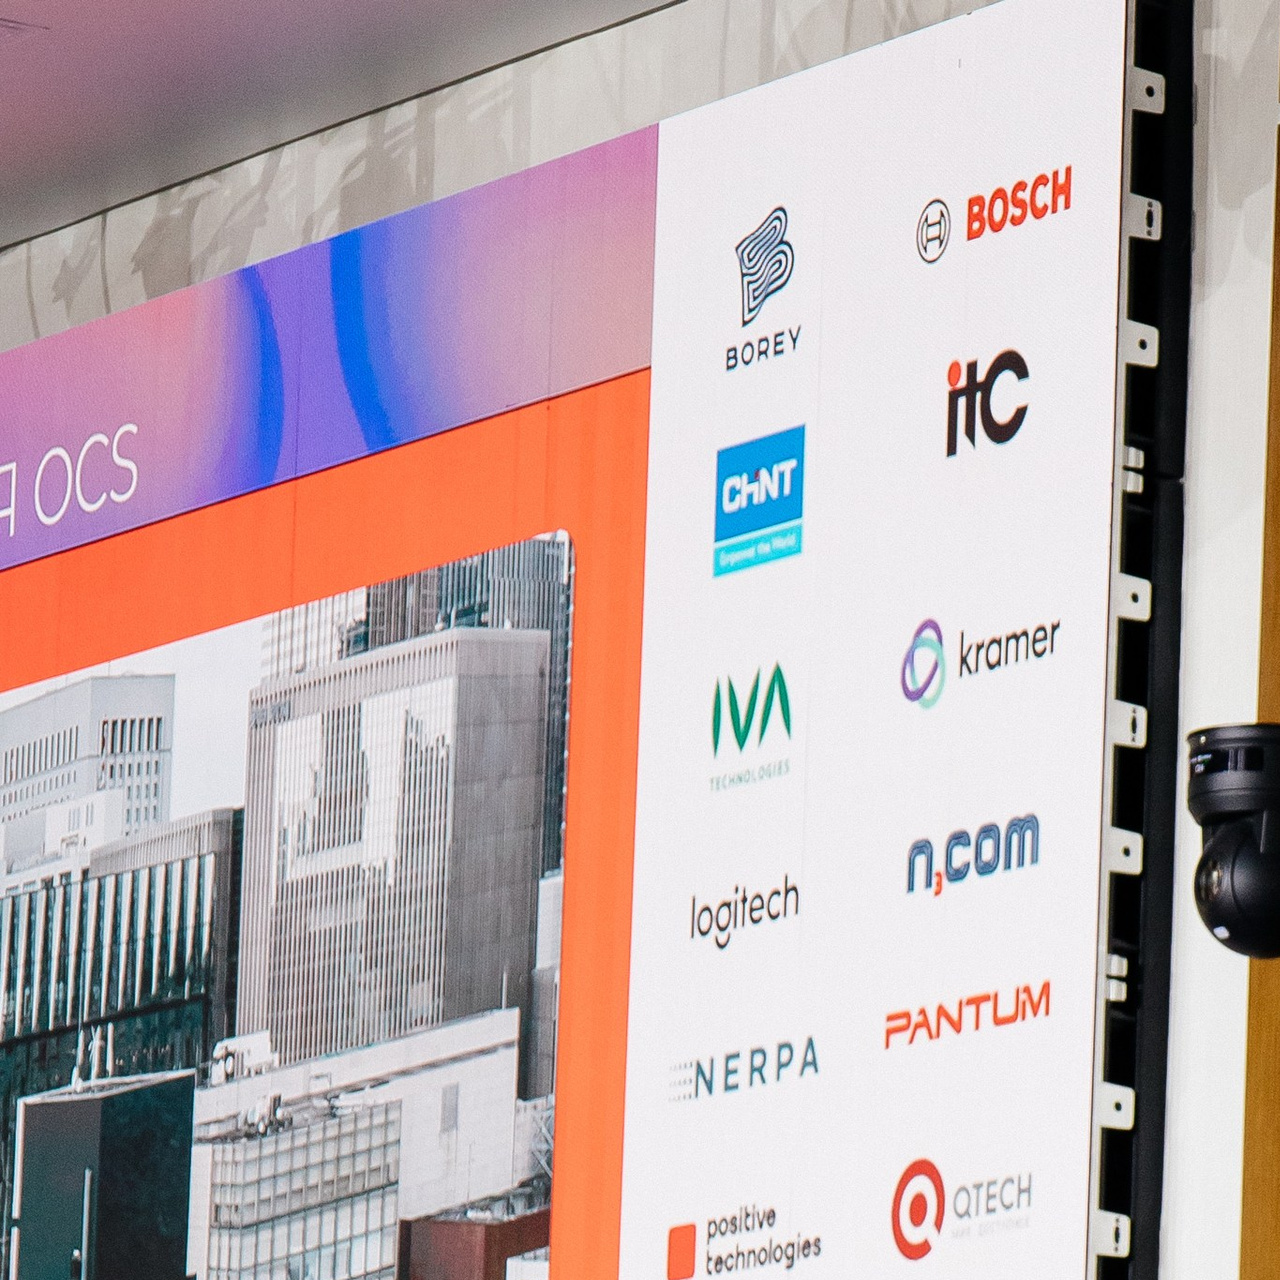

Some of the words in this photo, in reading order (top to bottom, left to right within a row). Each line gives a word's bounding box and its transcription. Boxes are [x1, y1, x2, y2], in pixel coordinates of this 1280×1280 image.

[967, 165, 1072, 241] BOSCH
[726, 325, 802, 372] BOREY
[34, 423, 138, 525] OCS
[960, 621, 1060, 677] kramer
[711, 661, 791, 759] IVA
[691, 875, 799, 950] logitech
[885, 981, 1050, 1049] PANTUM
[695, 1037, 818, 1098] NERPA
[706, 1204, 777, 1241] positive
[953, 1174, 1032, 1219] QTECH
[705, 1232, 822, 1276] technologies
